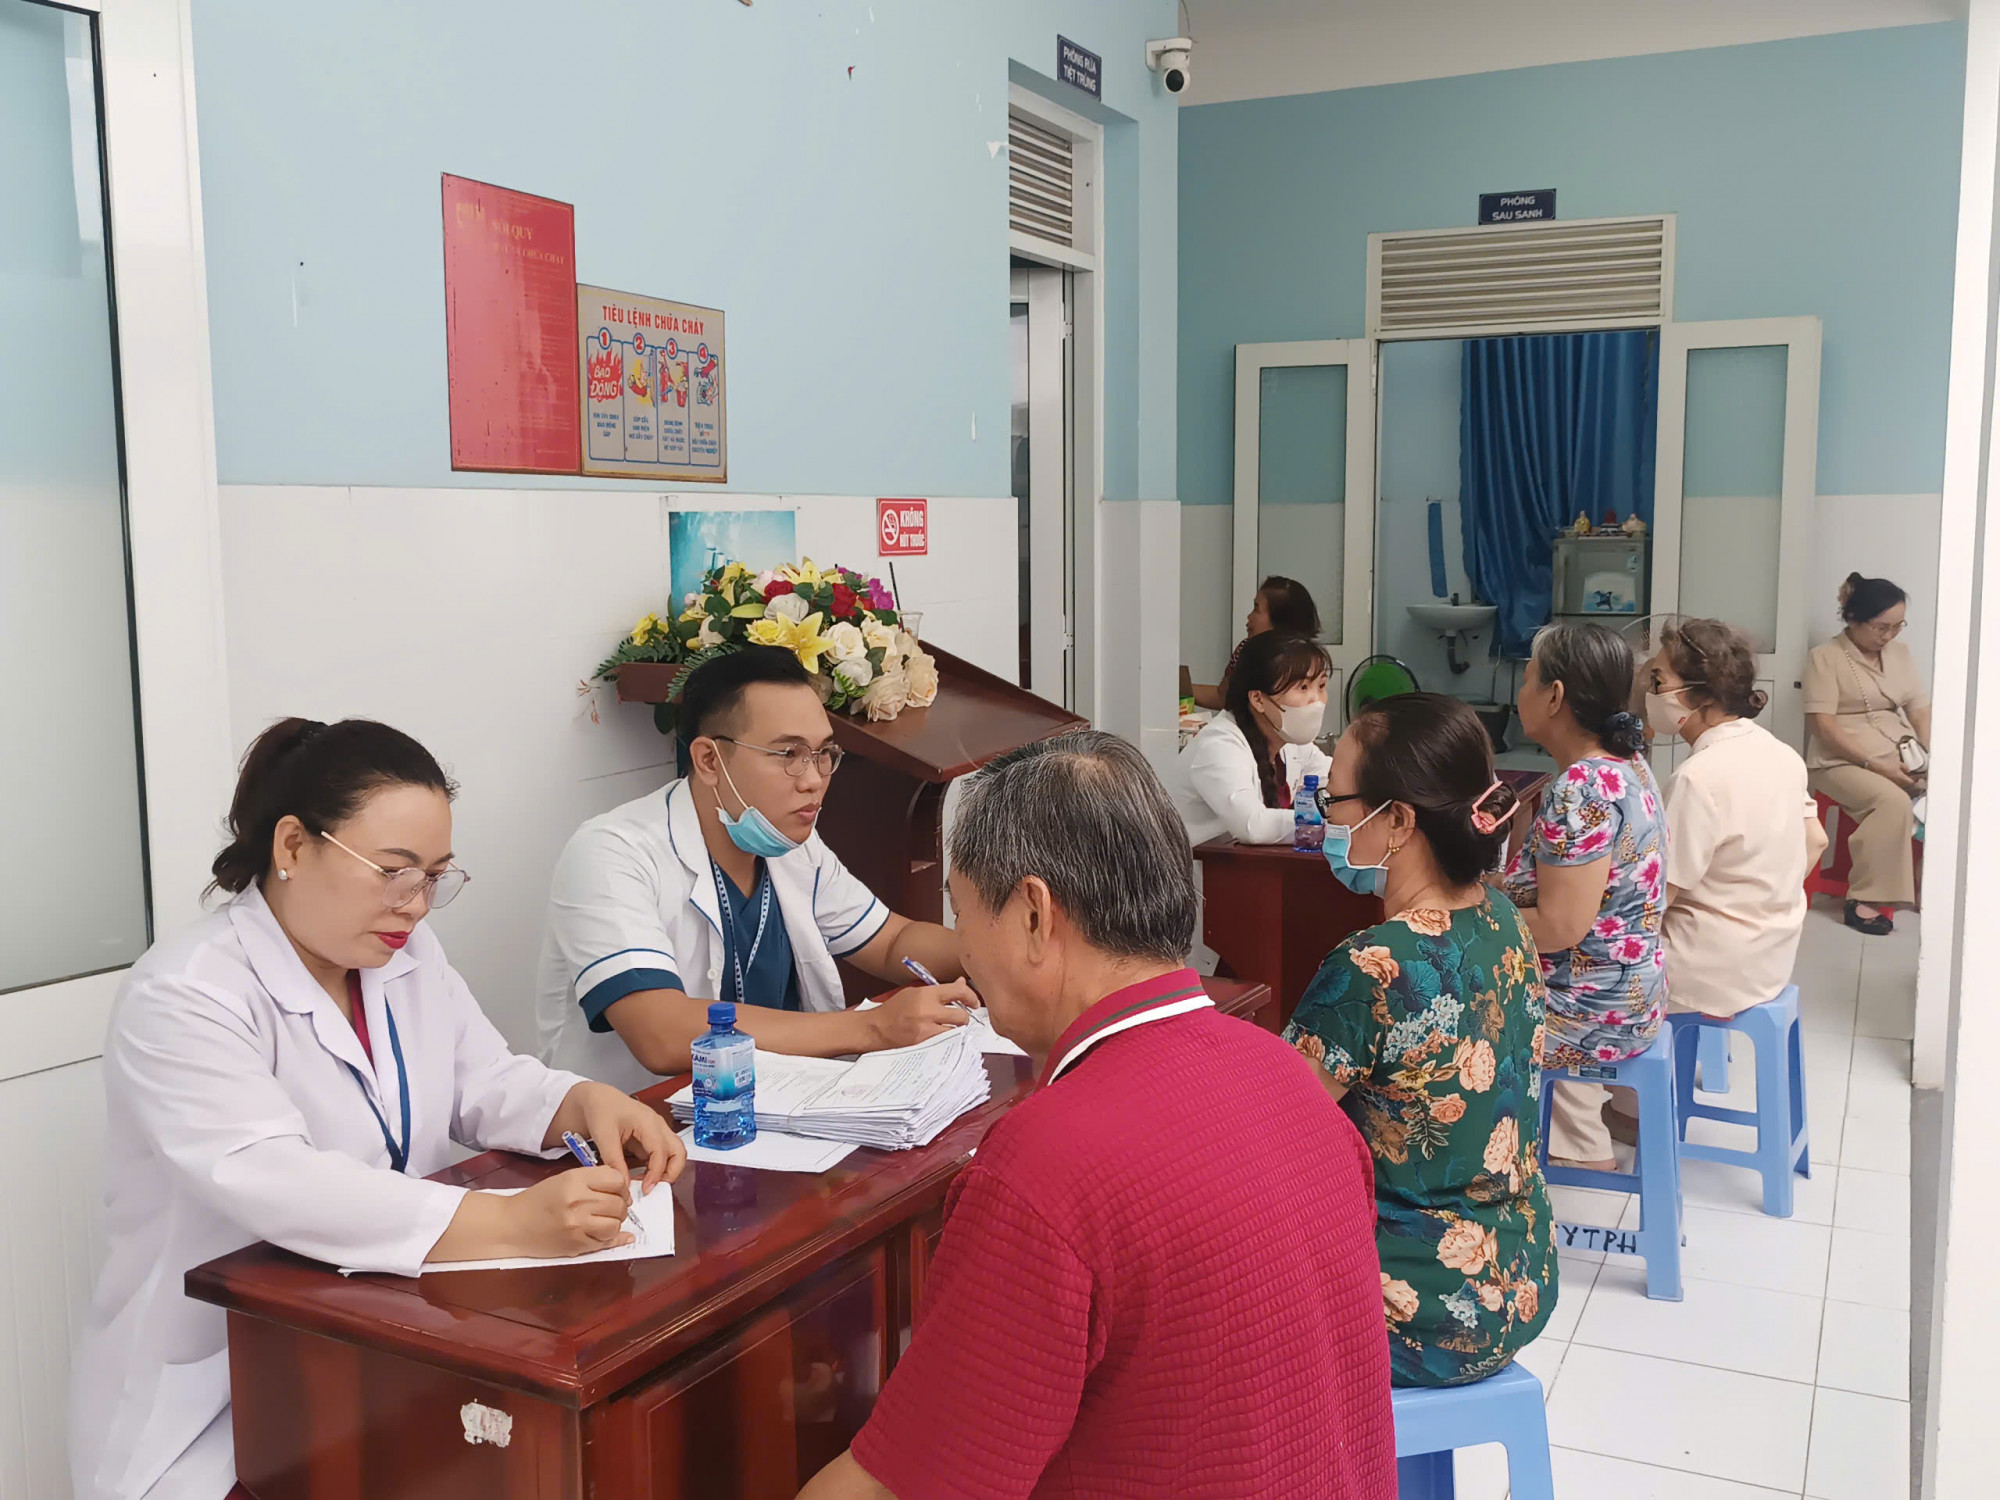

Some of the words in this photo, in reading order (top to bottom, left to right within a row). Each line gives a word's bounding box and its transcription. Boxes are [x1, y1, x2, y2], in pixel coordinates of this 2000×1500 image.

[1063, 45, 1084, 68] PHÒNG
[1500, 196, 1535, 207] PHÒNG
[1492, 211, 1513, 221] SAU
[1515, 209, 1543, 219] SANH
[602, 304, 624, 323] TIÊU
[627, 307, 651, 329] LỆNH
[655, 313, 679, 332] CHỮA
[682, 317, 704, 336] CHÁY
[601, 331, 608, 347] 1
[635, 335, 643, 351] 2
[668, 341, 676, 356] 3
[700, 346, 707, 360] 4
[900, 506, 924, 528] KHÔNG
[1555, 1224, 1637, 1254] YTPH
